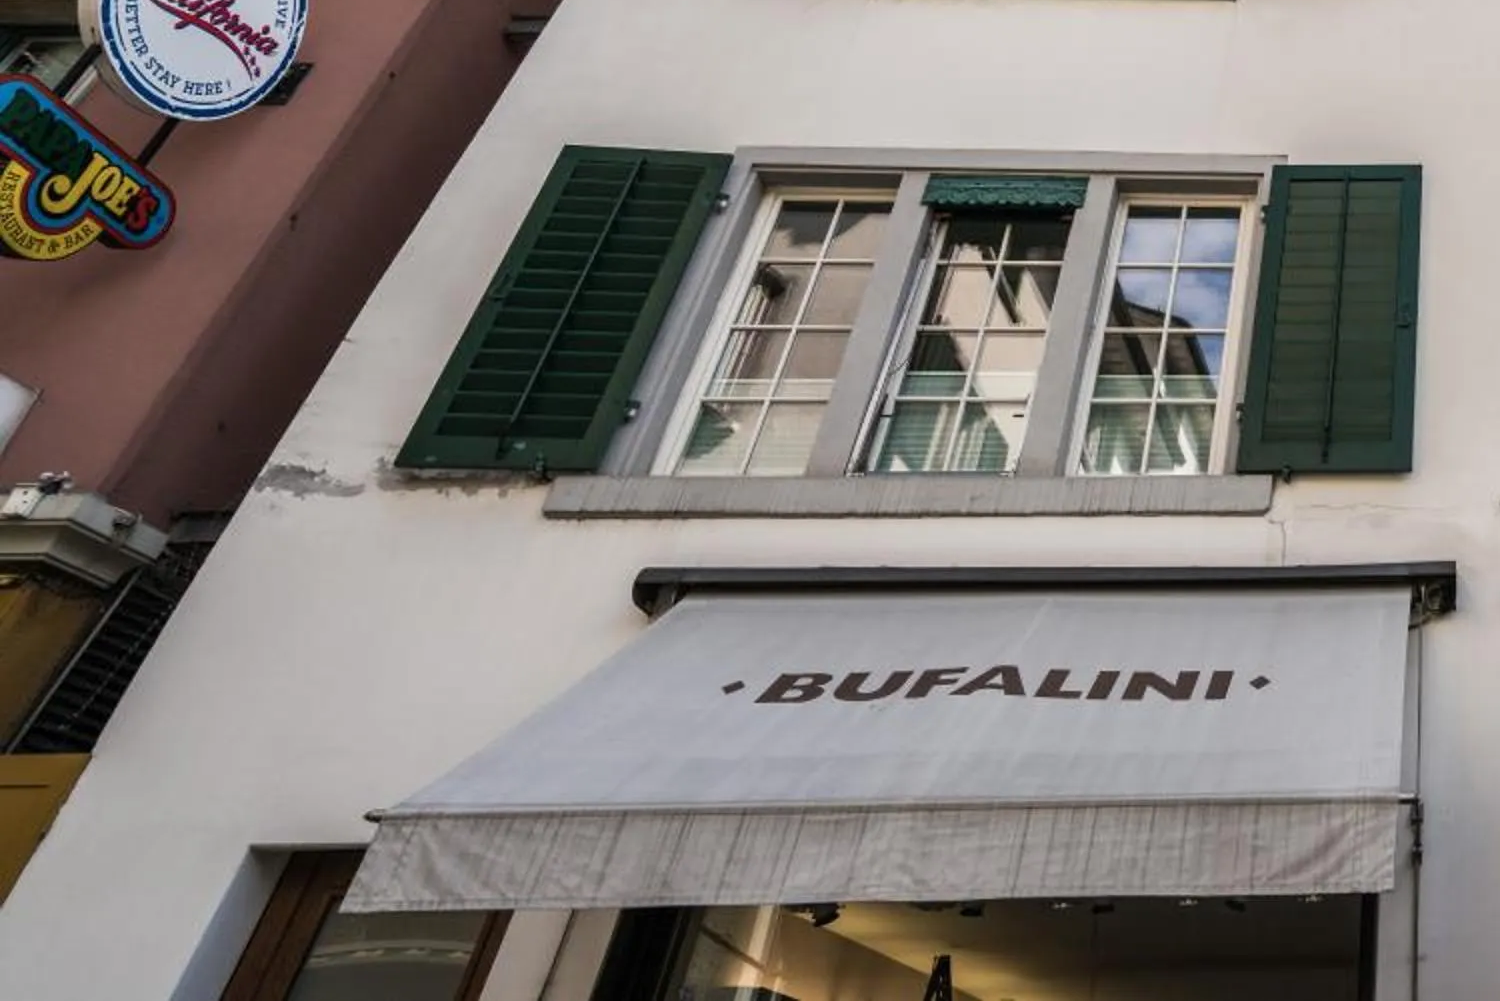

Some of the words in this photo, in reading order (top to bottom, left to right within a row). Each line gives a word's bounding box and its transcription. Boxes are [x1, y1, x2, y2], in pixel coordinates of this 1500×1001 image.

[144, 56, 182, 89] STAY
[0, 171, 46, 253] RESTAURANT
[63, 224, 95, 249] BAR
[753, 664, 1235, 704] BUFALINI
